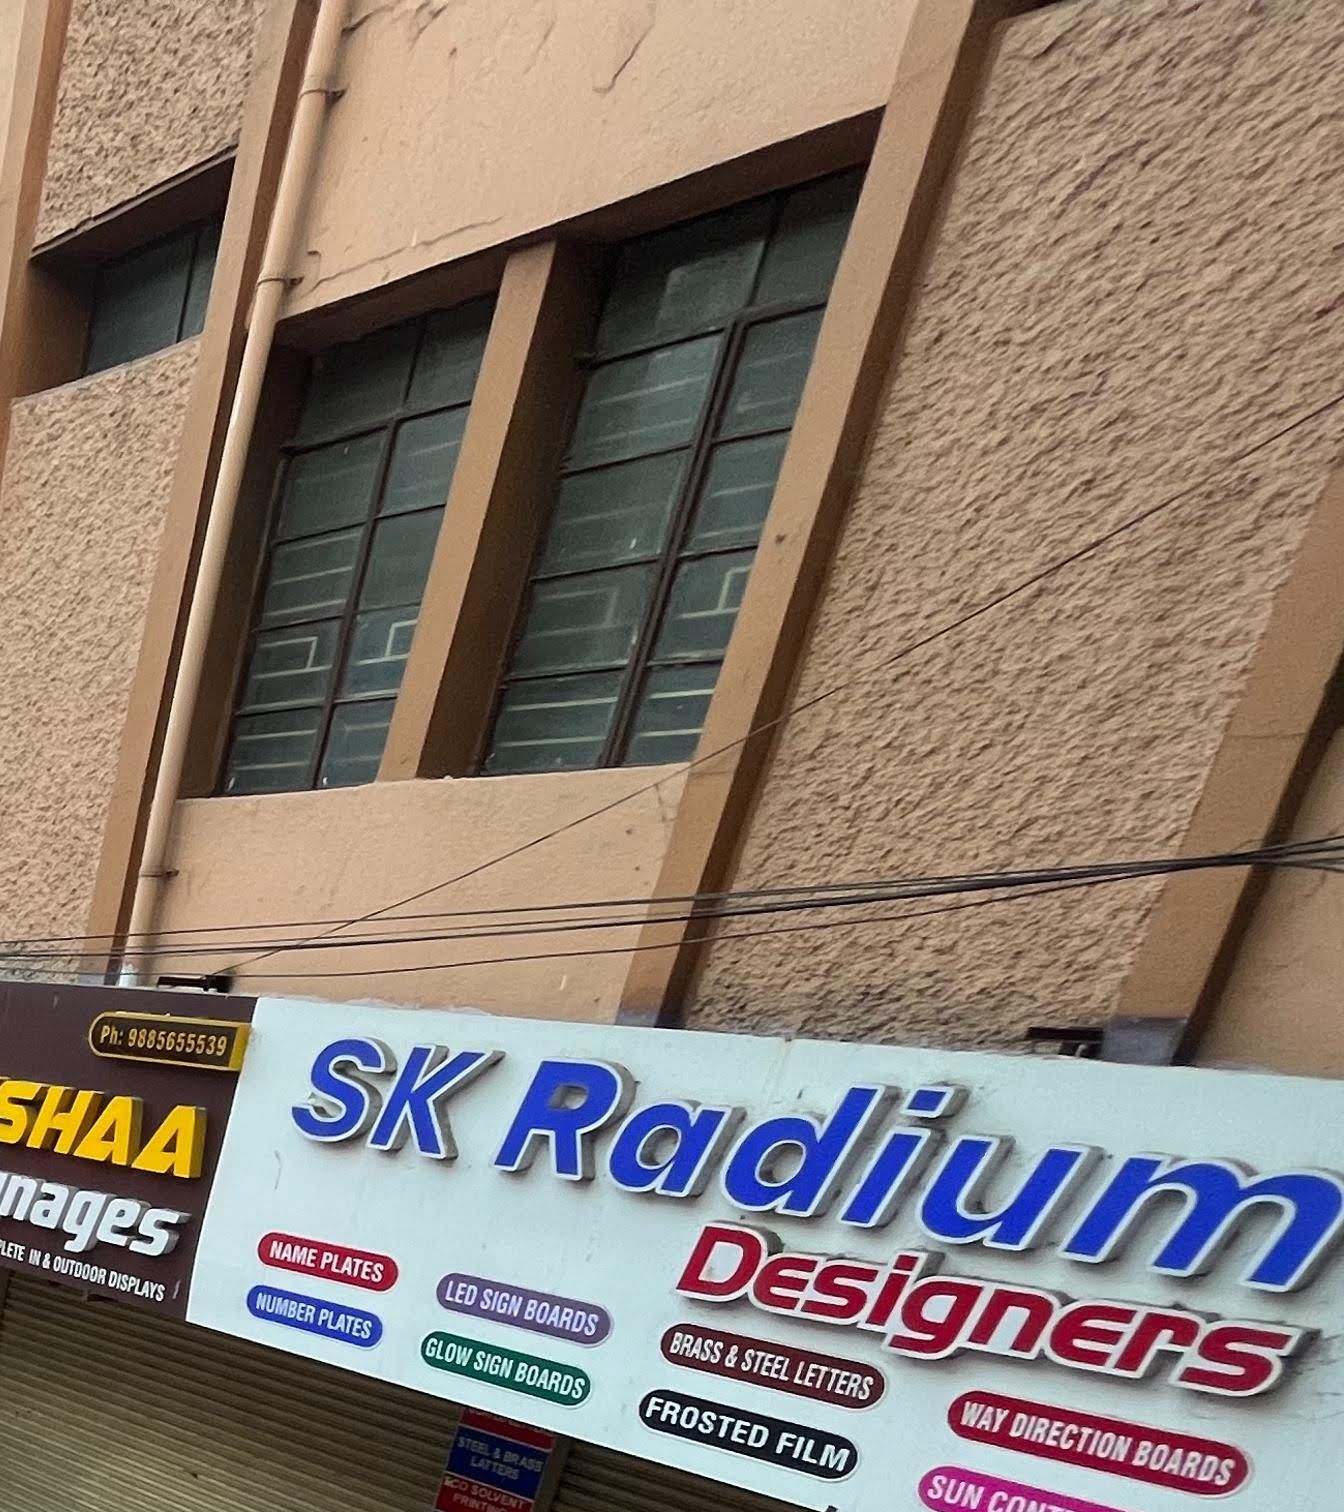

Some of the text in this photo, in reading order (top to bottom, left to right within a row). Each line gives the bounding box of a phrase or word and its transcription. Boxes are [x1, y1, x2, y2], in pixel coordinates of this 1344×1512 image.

[99, 1025, 228, 1057] Ph: 9885655539
[290, 1036, 1343, 1293] SK Radium
[269, 1239, 384, 1284] NAME PLATES
[255, 1292, 373, 1340] NUMBER PLATES
[445, 1281, 599, 1336] LED SIGN BOARDS
[675, 1220, 1307, 1397] Designers
[424, 1337, 585, 1398] GLOW SIGN BOARDS
[670, 1331, 875, 1401] BRASS & STEEL LETTERS
[458, 1436, 489, 1456] STEEL
[503, 1451, 544, 1472] BRASS
[645, 1395, 852, 1474] FROSTED FILM
[958, 1399, 1236, 1487] WAY DIRECTION BOARDS
[470, 1484, 525, 1509] SOLVENT
[926, 1474, 984, 1511] SUN
